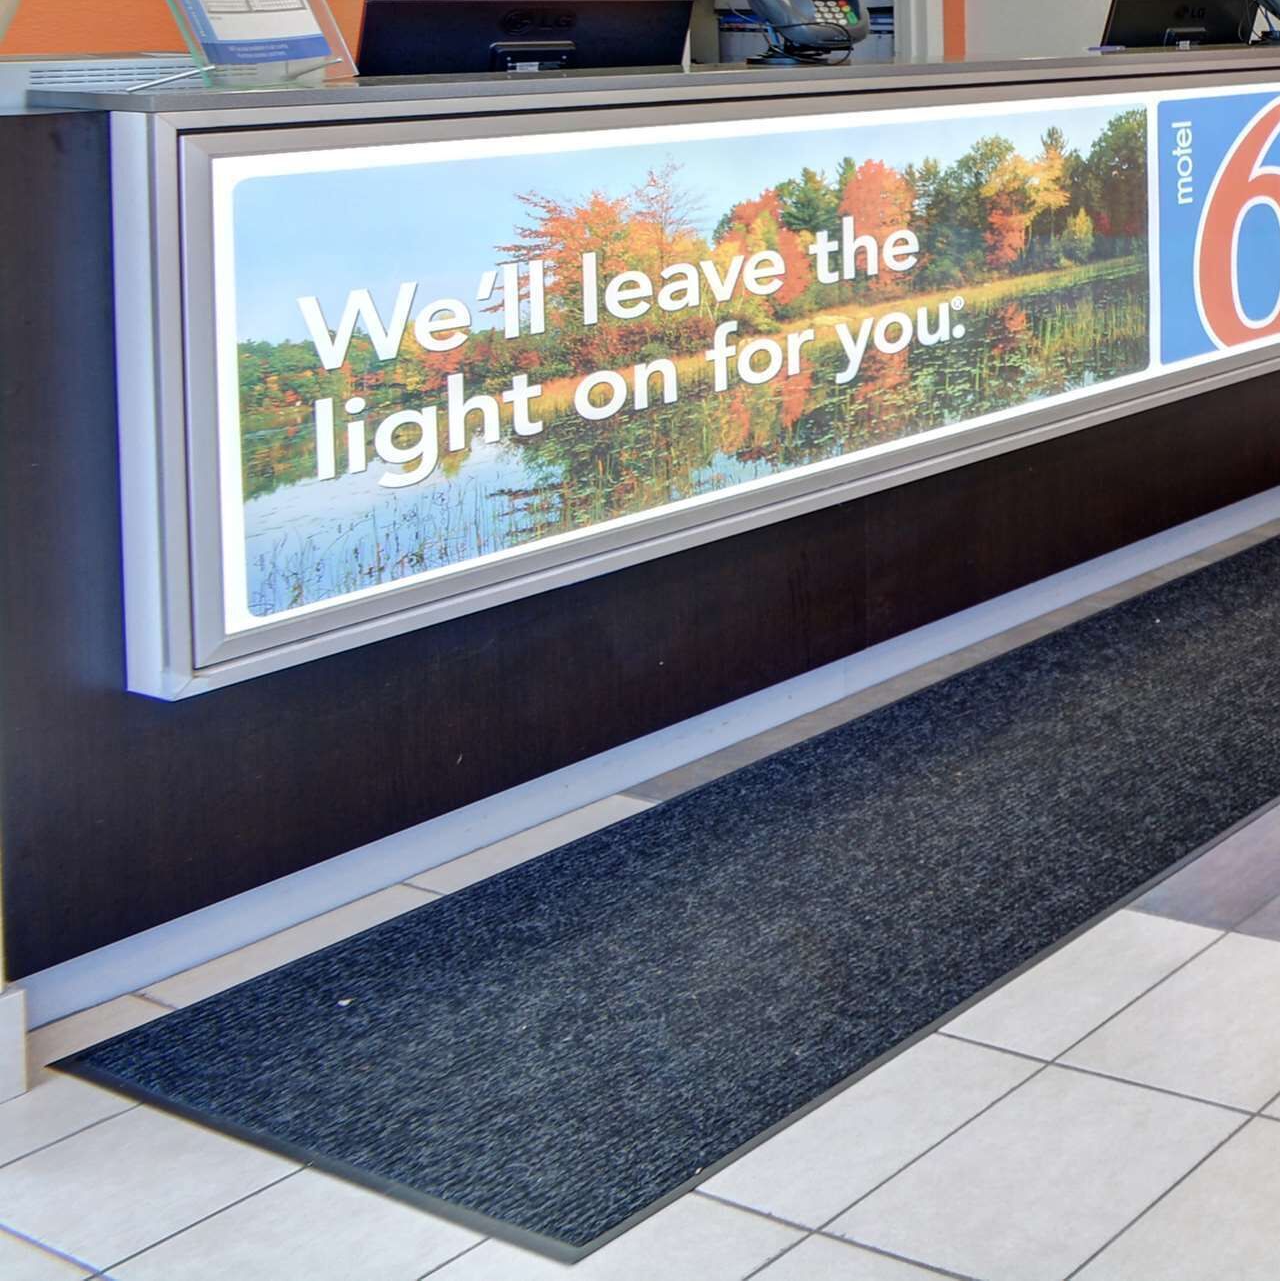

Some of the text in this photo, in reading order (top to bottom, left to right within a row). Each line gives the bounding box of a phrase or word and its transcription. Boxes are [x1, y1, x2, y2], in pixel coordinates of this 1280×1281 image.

[1172, 120, 1193, 205] motel
[296, 216, 920, 371] We'll leave the
[315, 373, 544, 488] light
[574, 358, 678, 420] on
[705, 320, 814, 392] for
